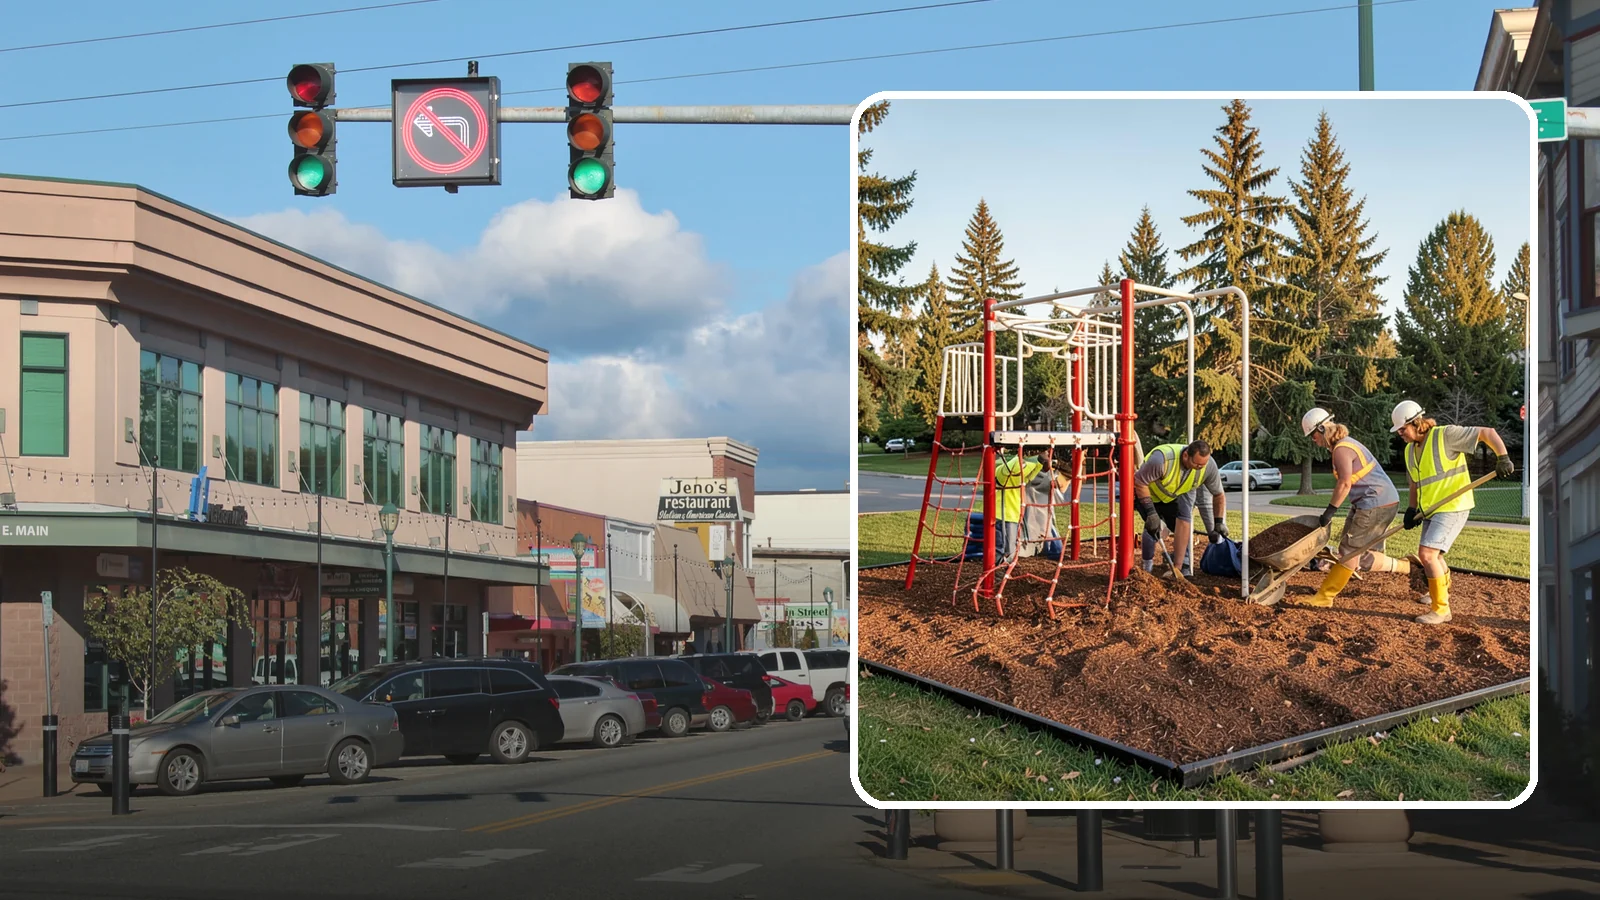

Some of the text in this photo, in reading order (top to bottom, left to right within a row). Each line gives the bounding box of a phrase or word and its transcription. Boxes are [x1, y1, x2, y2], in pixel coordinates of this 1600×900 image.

[670, 480, 727, 494] Jeno's
[665, 496, 731, 509] restaurant
[658, 509, 681, 519] Italian
[686, 509, 714, 519] American
[715, 509, 737, 519] Cuisine
[2, 525, 49, 536] E. MAIN
[785, 607, 828, 617] in Street
[790, 619, 824, 627] lass
